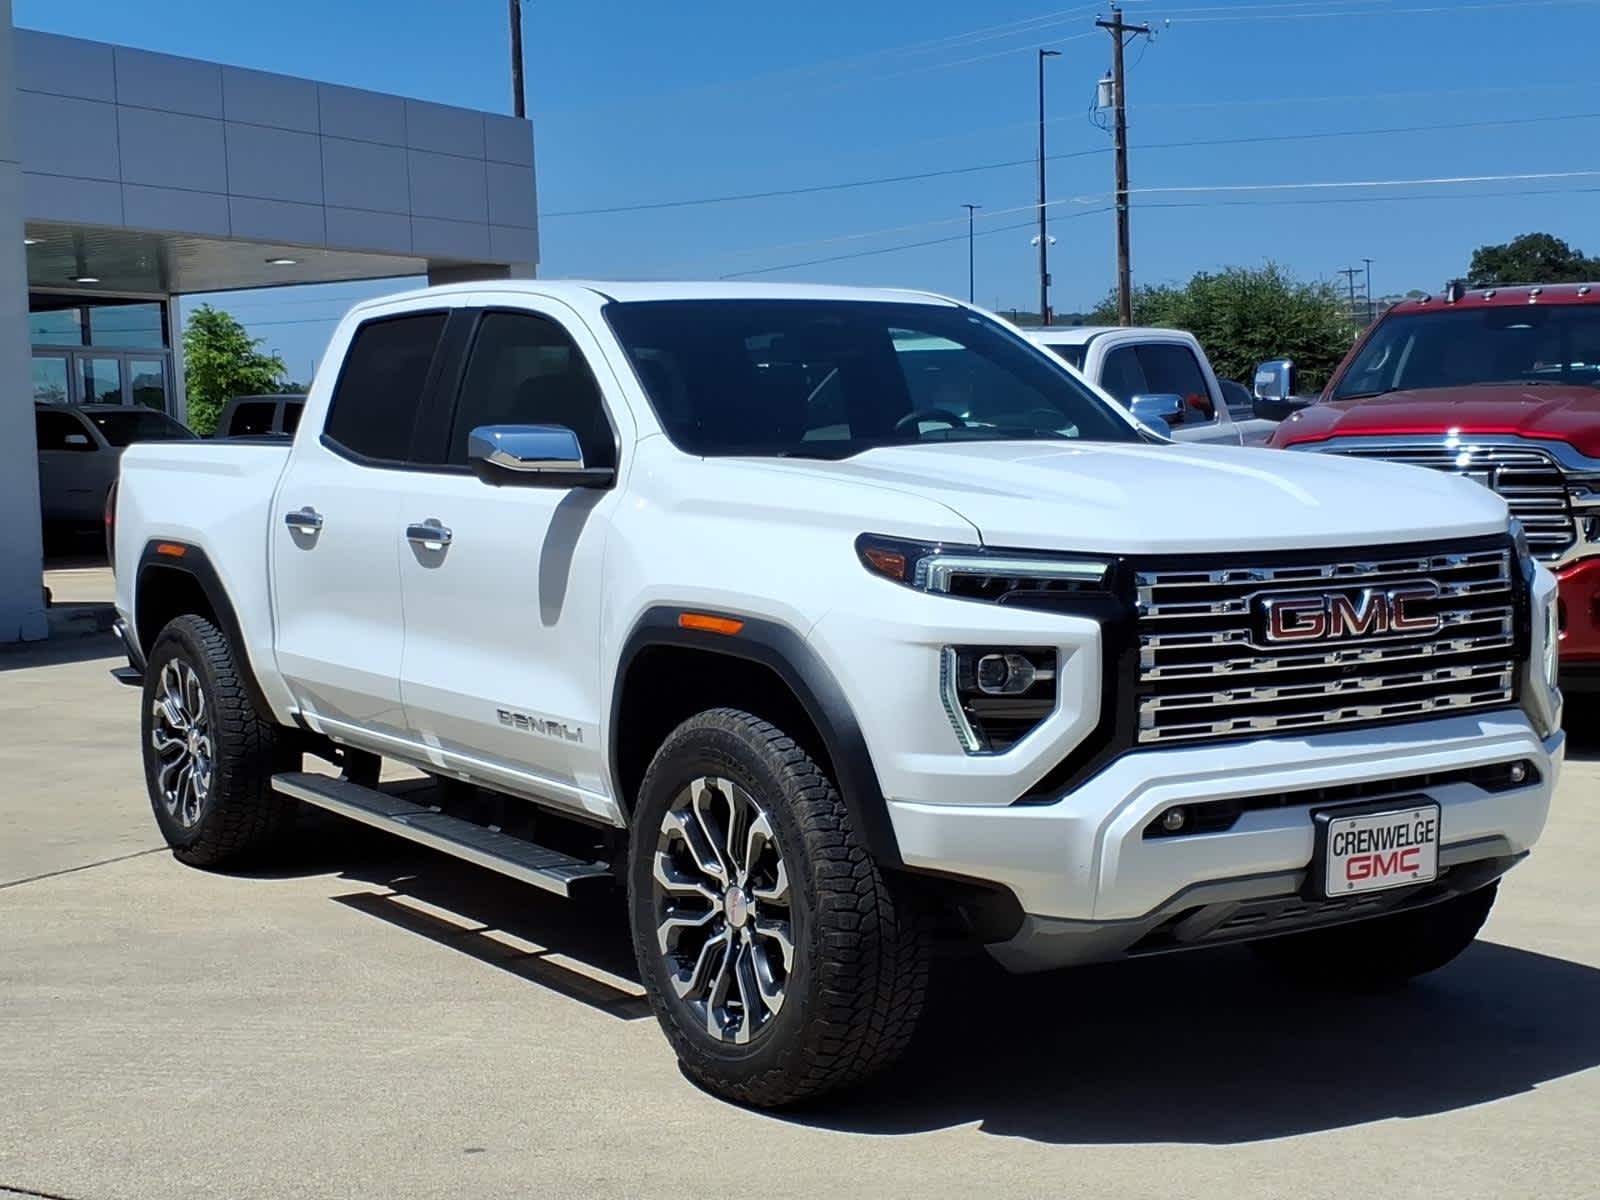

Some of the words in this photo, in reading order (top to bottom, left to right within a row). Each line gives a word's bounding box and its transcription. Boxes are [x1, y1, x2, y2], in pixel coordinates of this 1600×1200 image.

[1266, 588, 1439, 641] GMC
[496, 708, 583, 743] DENALI
[1333, 820, 1434, 856] CRENWELGE
[1346, 848, 1420, 880] GMC
